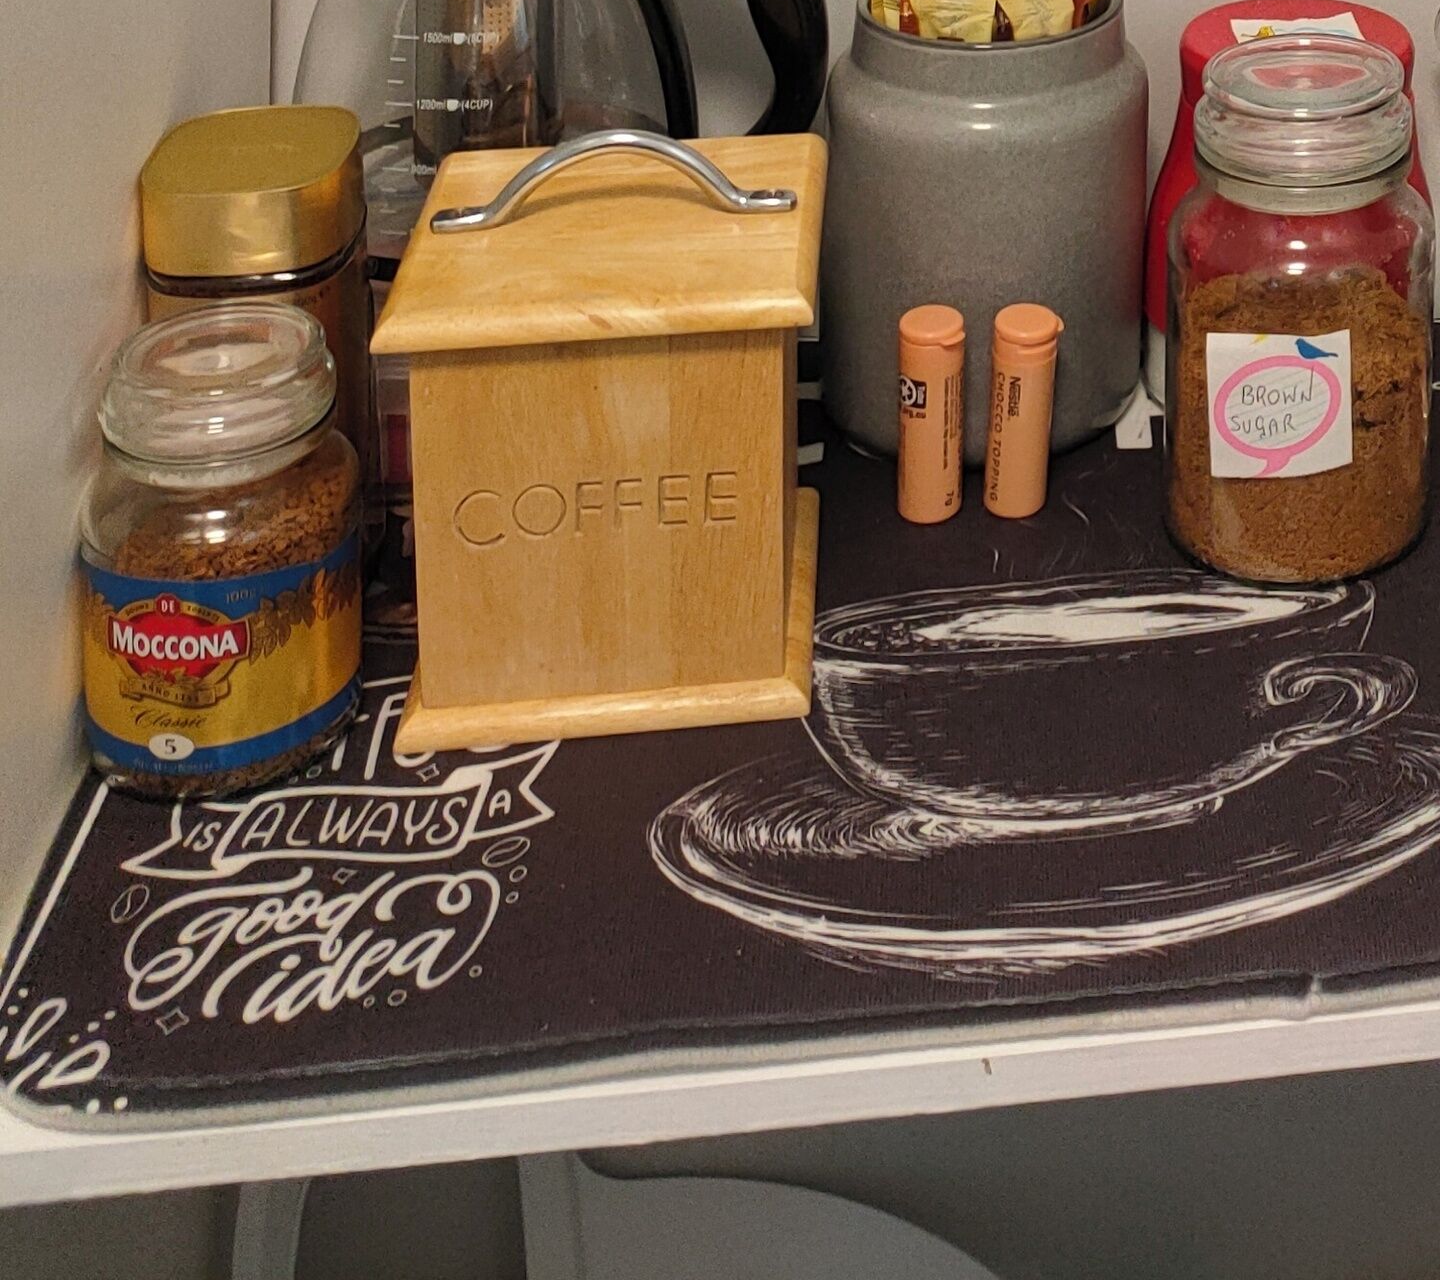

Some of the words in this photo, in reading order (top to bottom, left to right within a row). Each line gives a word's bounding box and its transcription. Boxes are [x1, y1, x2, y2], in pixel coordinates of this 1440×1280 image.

[416, 98, 446, 110] 1200ml
[461, 99, 493, 112] (4CUP)
[1241, 366, 1314, 407] BROWN
[1230, 413, 1296, 440] SUGAR
[989, 440, 1002, 501] TOPPING
[453, 471, 737, 546] COFFEE
[161, 599, 175, 613] DE
[112, 621, 239, 661] MOCCONA
[130, 704, 208, 729] Classic
[164, 739, 177, 755] 5
[183, 821, 223, 851] IS
[242, 797, 467, 848] ALWAYS
[488, 788, 511, 818] A
[125, 867, 395, 1010] good
[202, 910, 500, 1024] idea
